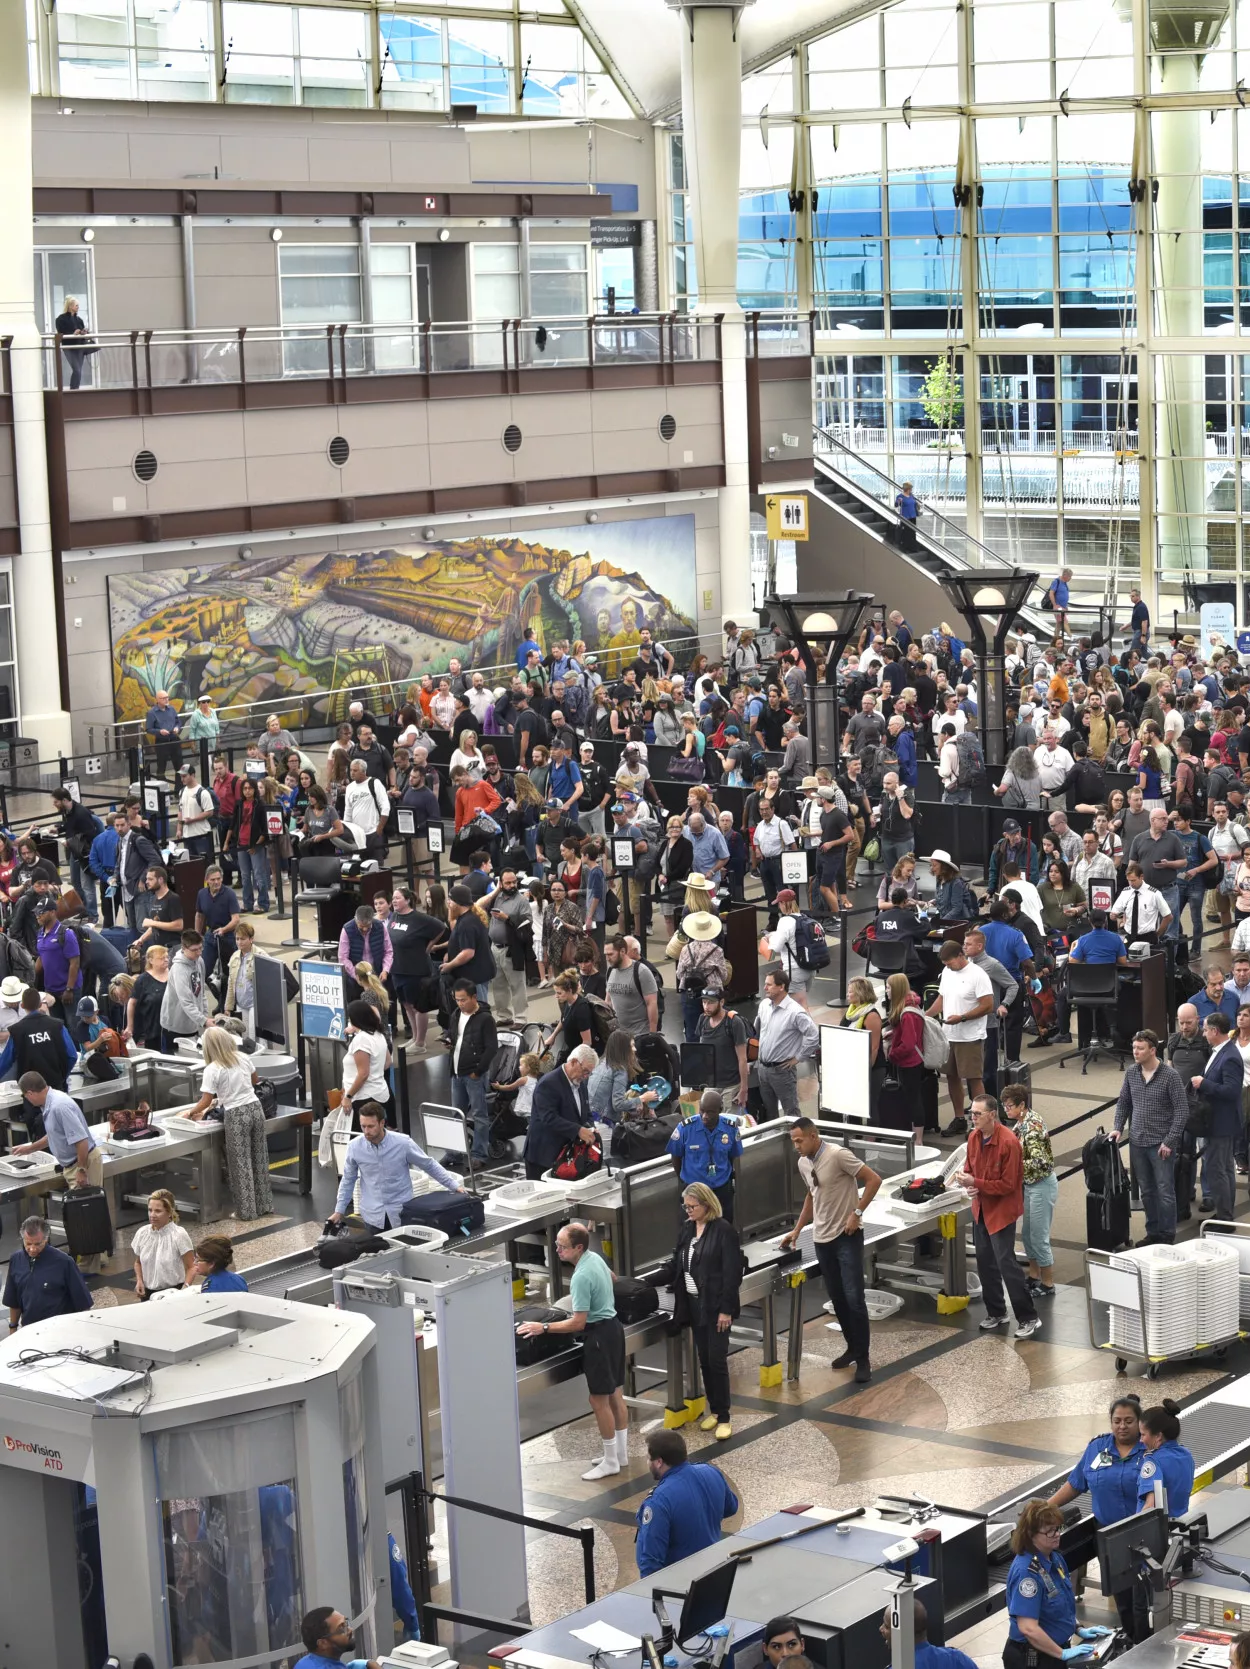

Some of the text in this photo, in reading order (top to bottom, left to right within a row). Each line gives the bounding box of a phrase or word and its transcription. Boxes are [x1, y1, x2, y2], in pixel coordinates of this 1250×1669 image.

[268, 821, 281, 829] STOP
[1093, 897, 1110, 905] STOP
[882, 920, 898, 930] TSA
[304, 974, 330, 984] EMPTY
[305, 984, 339, 996] HOLD IT
[305, 994, 339, 1006] REFILL IT
[29, 1031, 51, 1045] TSA
[15, 1440, 62, 1459] ProVision
[44, 1458, 63, 1471] ATD
